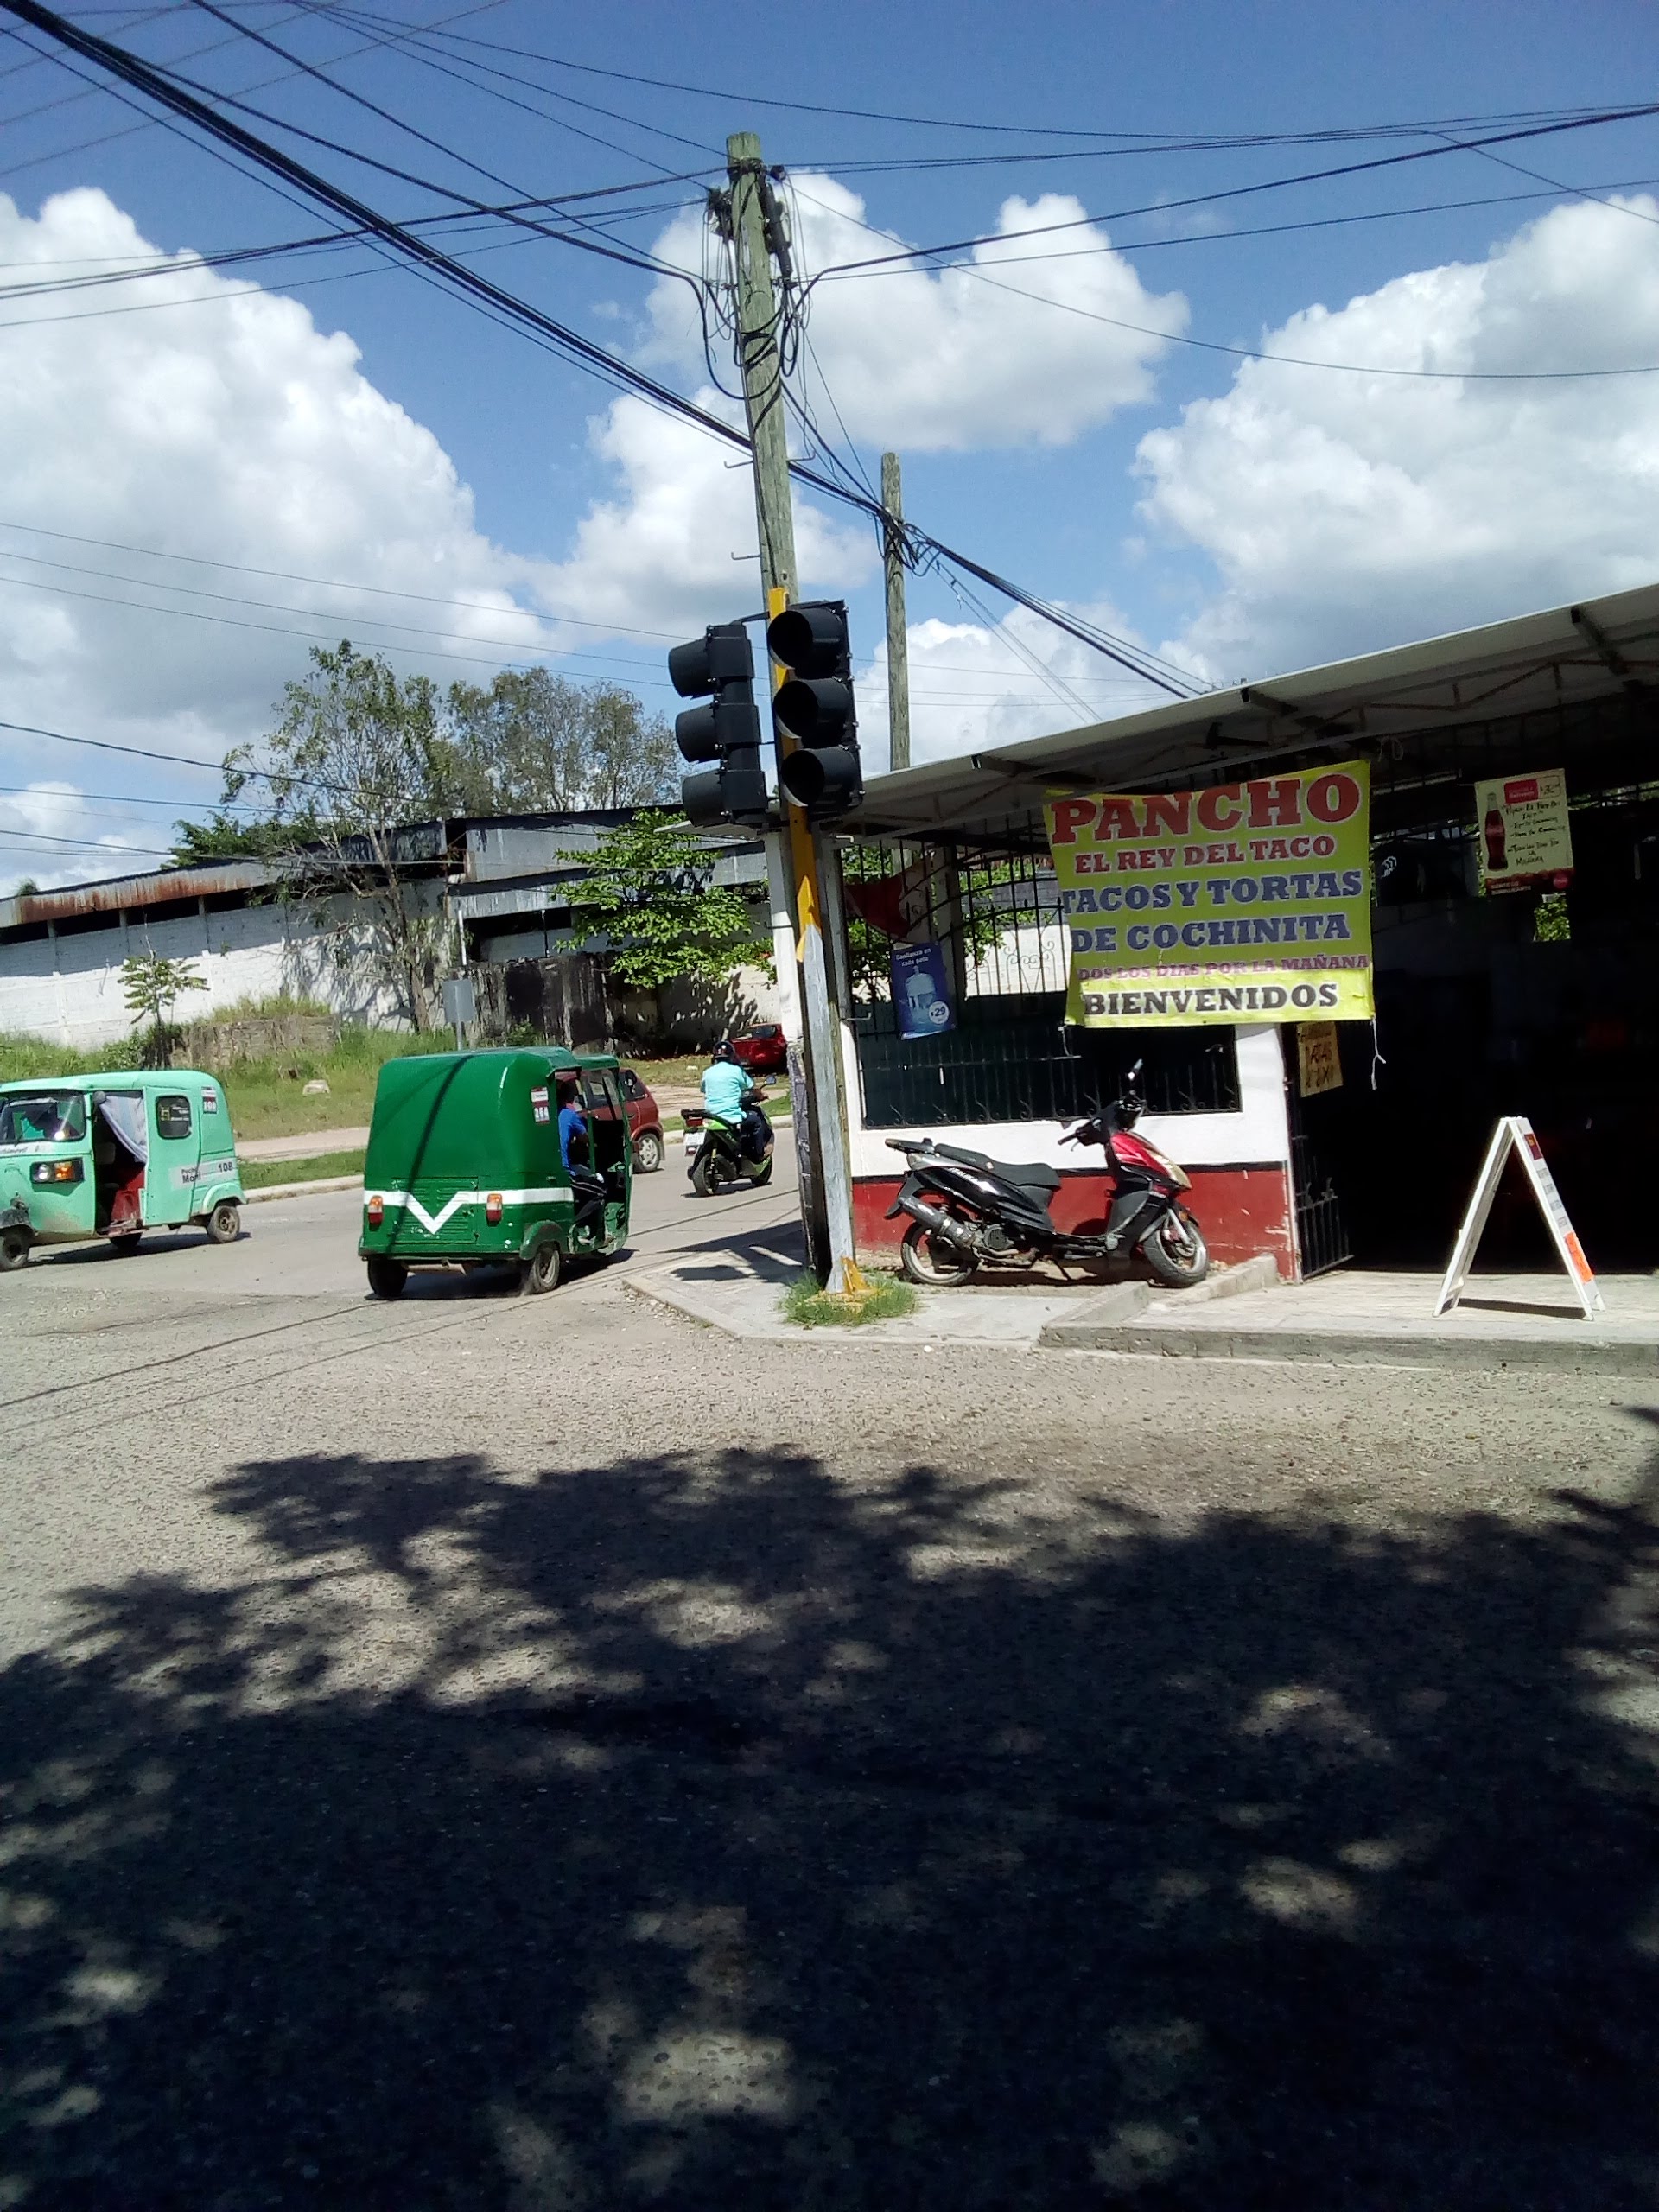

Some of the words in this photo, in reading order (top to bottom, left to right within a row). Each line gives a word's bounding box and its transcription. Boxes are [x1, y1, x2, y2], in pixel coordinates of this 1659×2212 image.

[1051, 773, 1360, 844] PANCHO
[1075, 854, 1111, 874] EL
[1117, 848, 1176, 870] REY
[1185, 843, 1245, 866] DEL
[1249, 836, 1335, 861] TACO
[1063, 884, 1171, 914] TACOS
[1177, 881, 1200, 906] Y
[1207, 871, 1362, 905] TORTAS
[1071, 927, 1116, 951] DE
[1127, 913, 1350, 949] COCHINITA
[1117, 966, 1151, 979] LOS
[1205, 961, 1247, 975] POR
[1253, 960, 1276, 972] LA
[1281, 953, 1368, 970] MAÑANA
[1084, 983, 1338, 1015] BIENVENIDOS
[219, 1162, 233, 1173] 108
